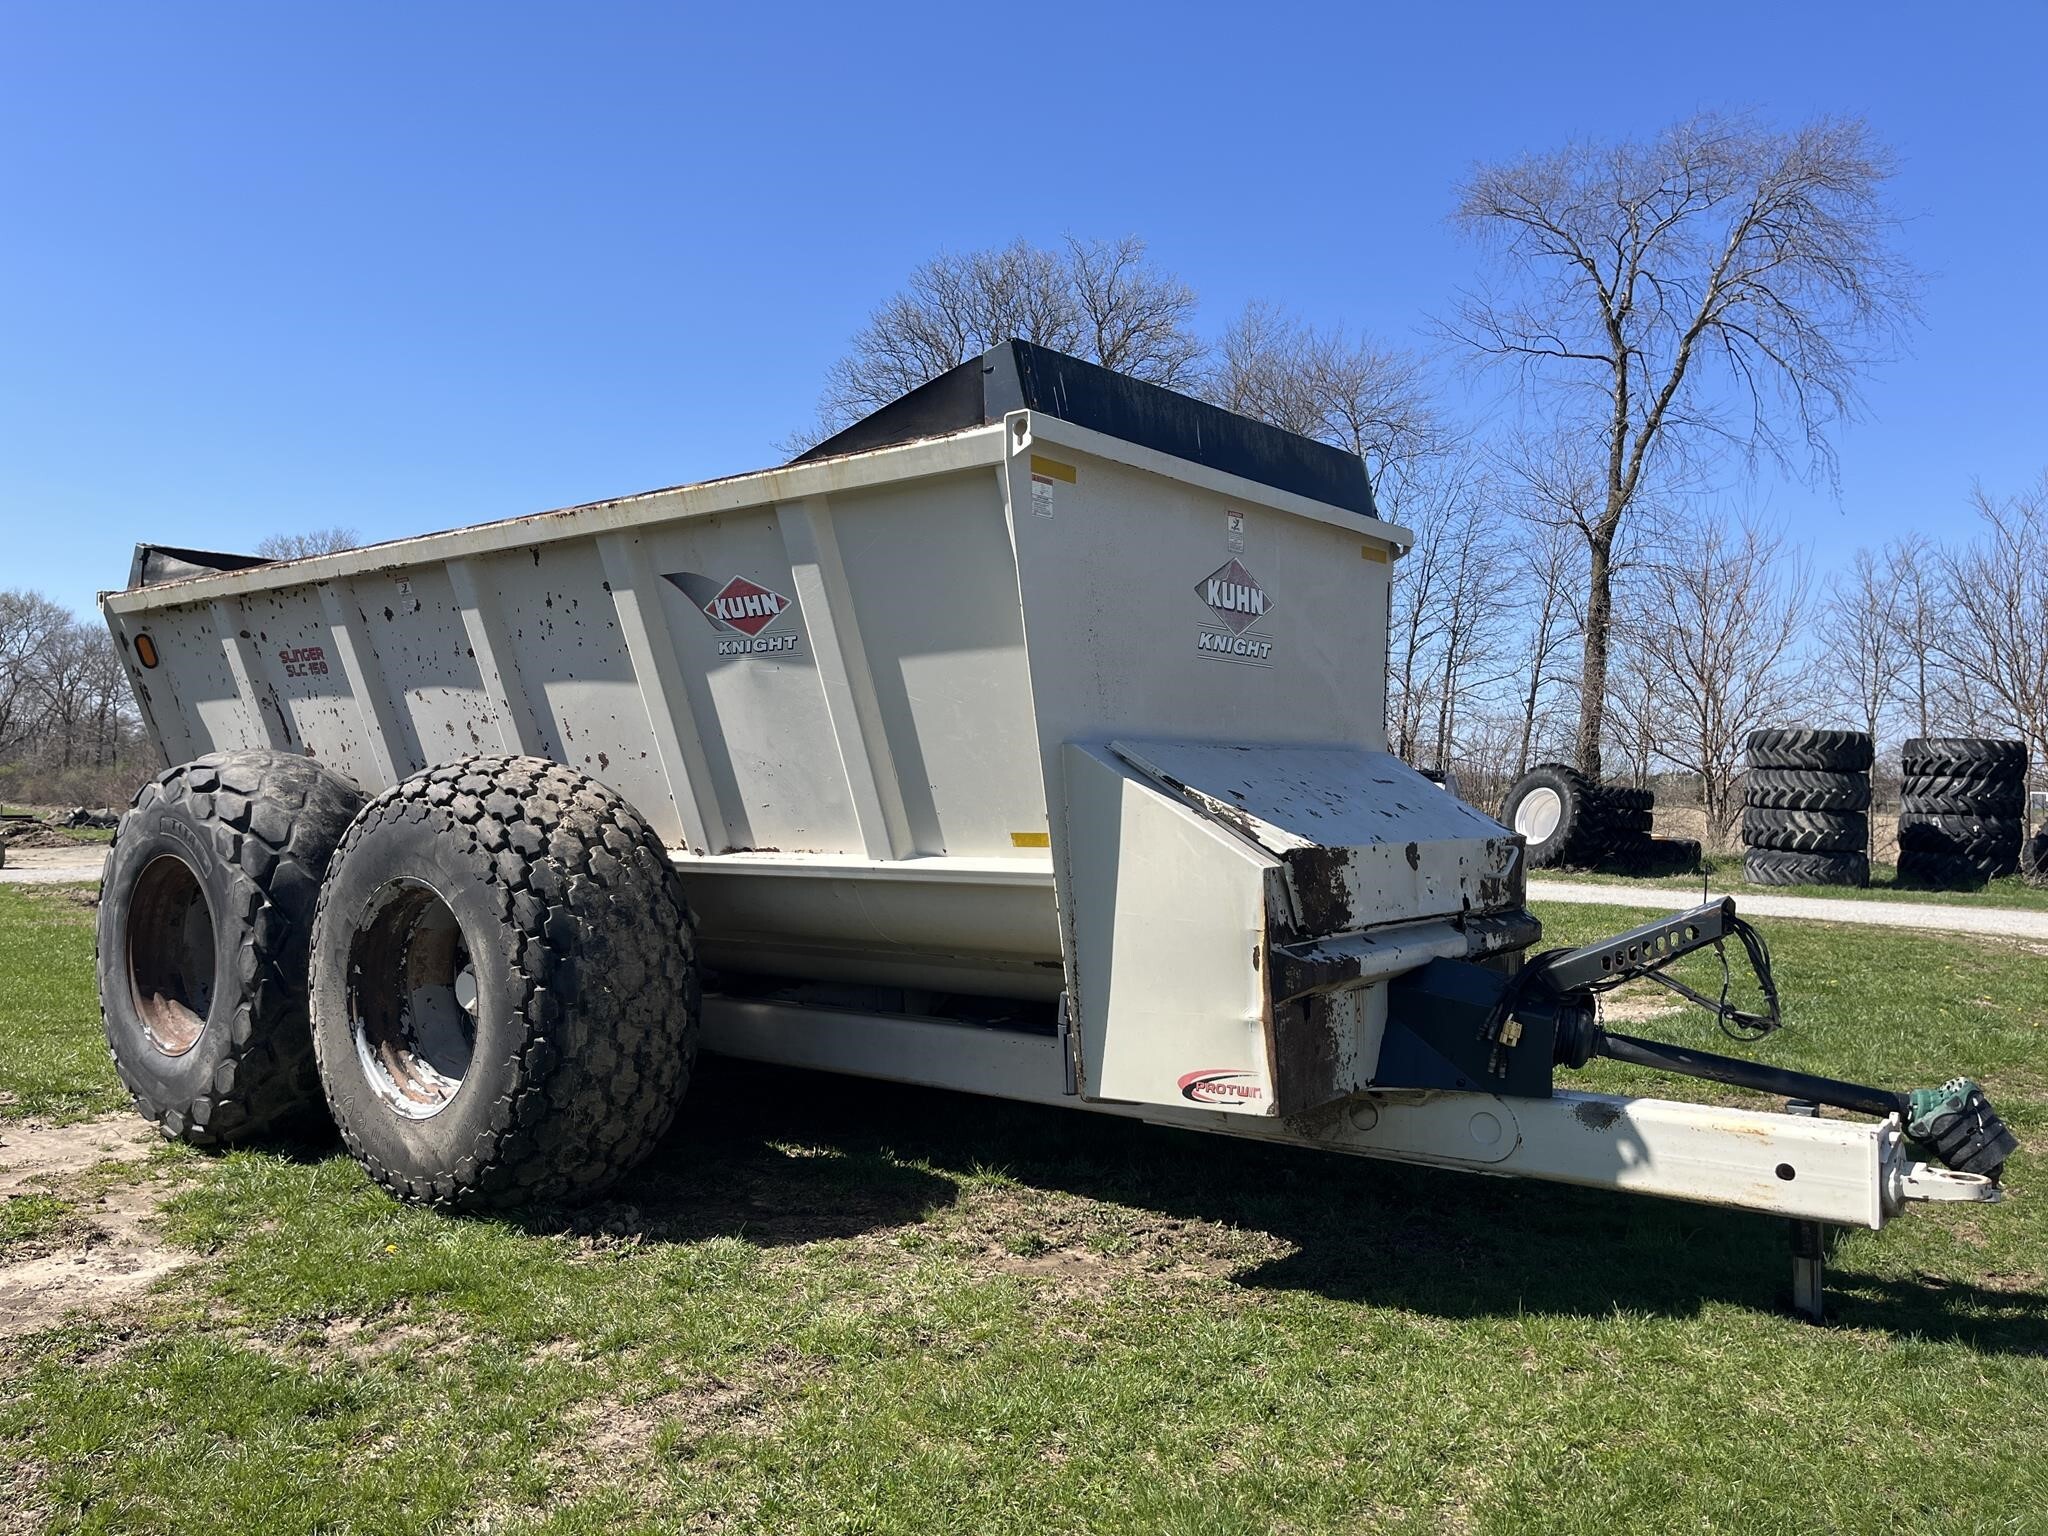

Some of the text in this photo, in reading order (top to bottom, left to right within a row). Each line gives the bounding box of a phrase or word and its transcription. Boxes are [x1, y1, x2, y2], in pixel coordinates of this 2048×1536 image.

[713, 592, 780, 620] KUHN
[1207, 578, 1264, 616] KUHN
[279, 647, 325, 664] SLINGER
[718, 635, 798, 656] KNIGHT
[1198, 632, 1272, 659] KNIGHT
